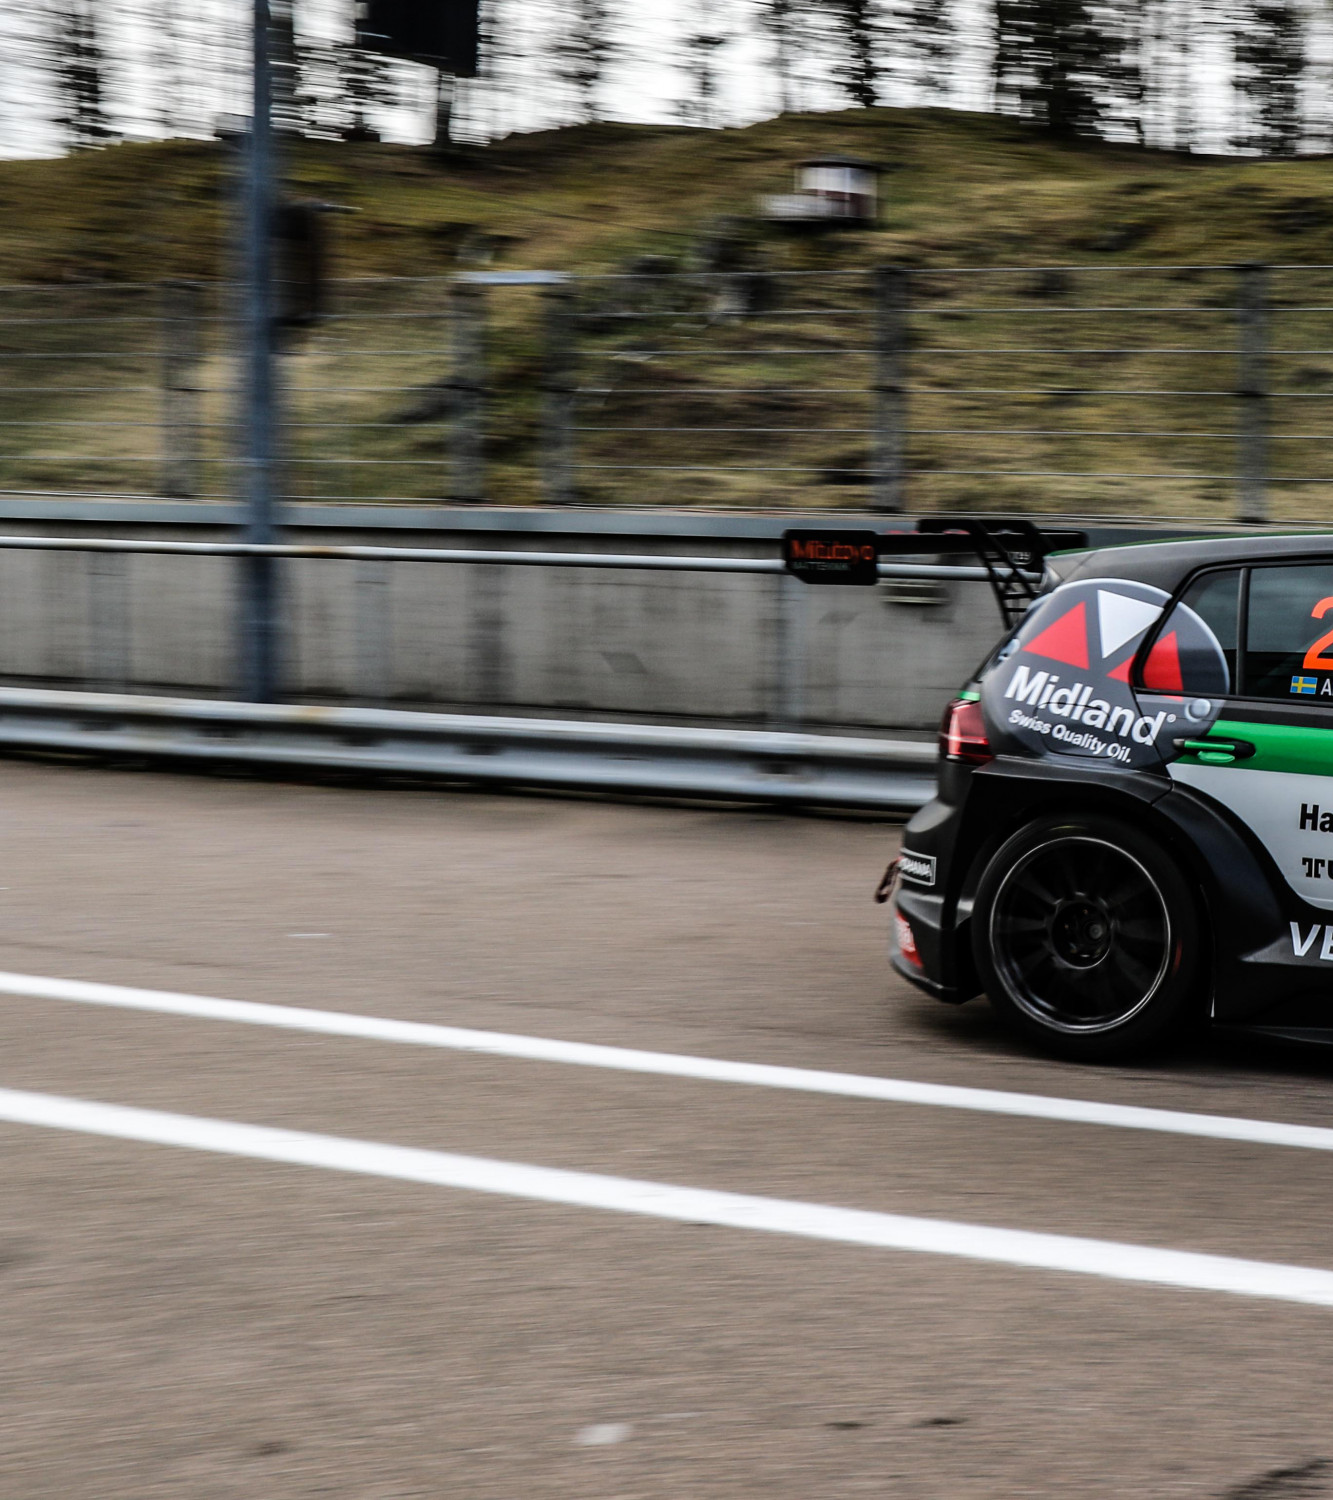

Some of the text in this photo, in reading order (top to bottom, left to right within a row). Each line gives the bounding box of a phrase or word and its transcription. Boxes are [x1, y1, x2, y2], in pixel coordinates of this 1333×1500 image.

[1004, 665, 1167, 746] Midland
[1008, 709, 1132, 763] Swiss Quality Oil.
